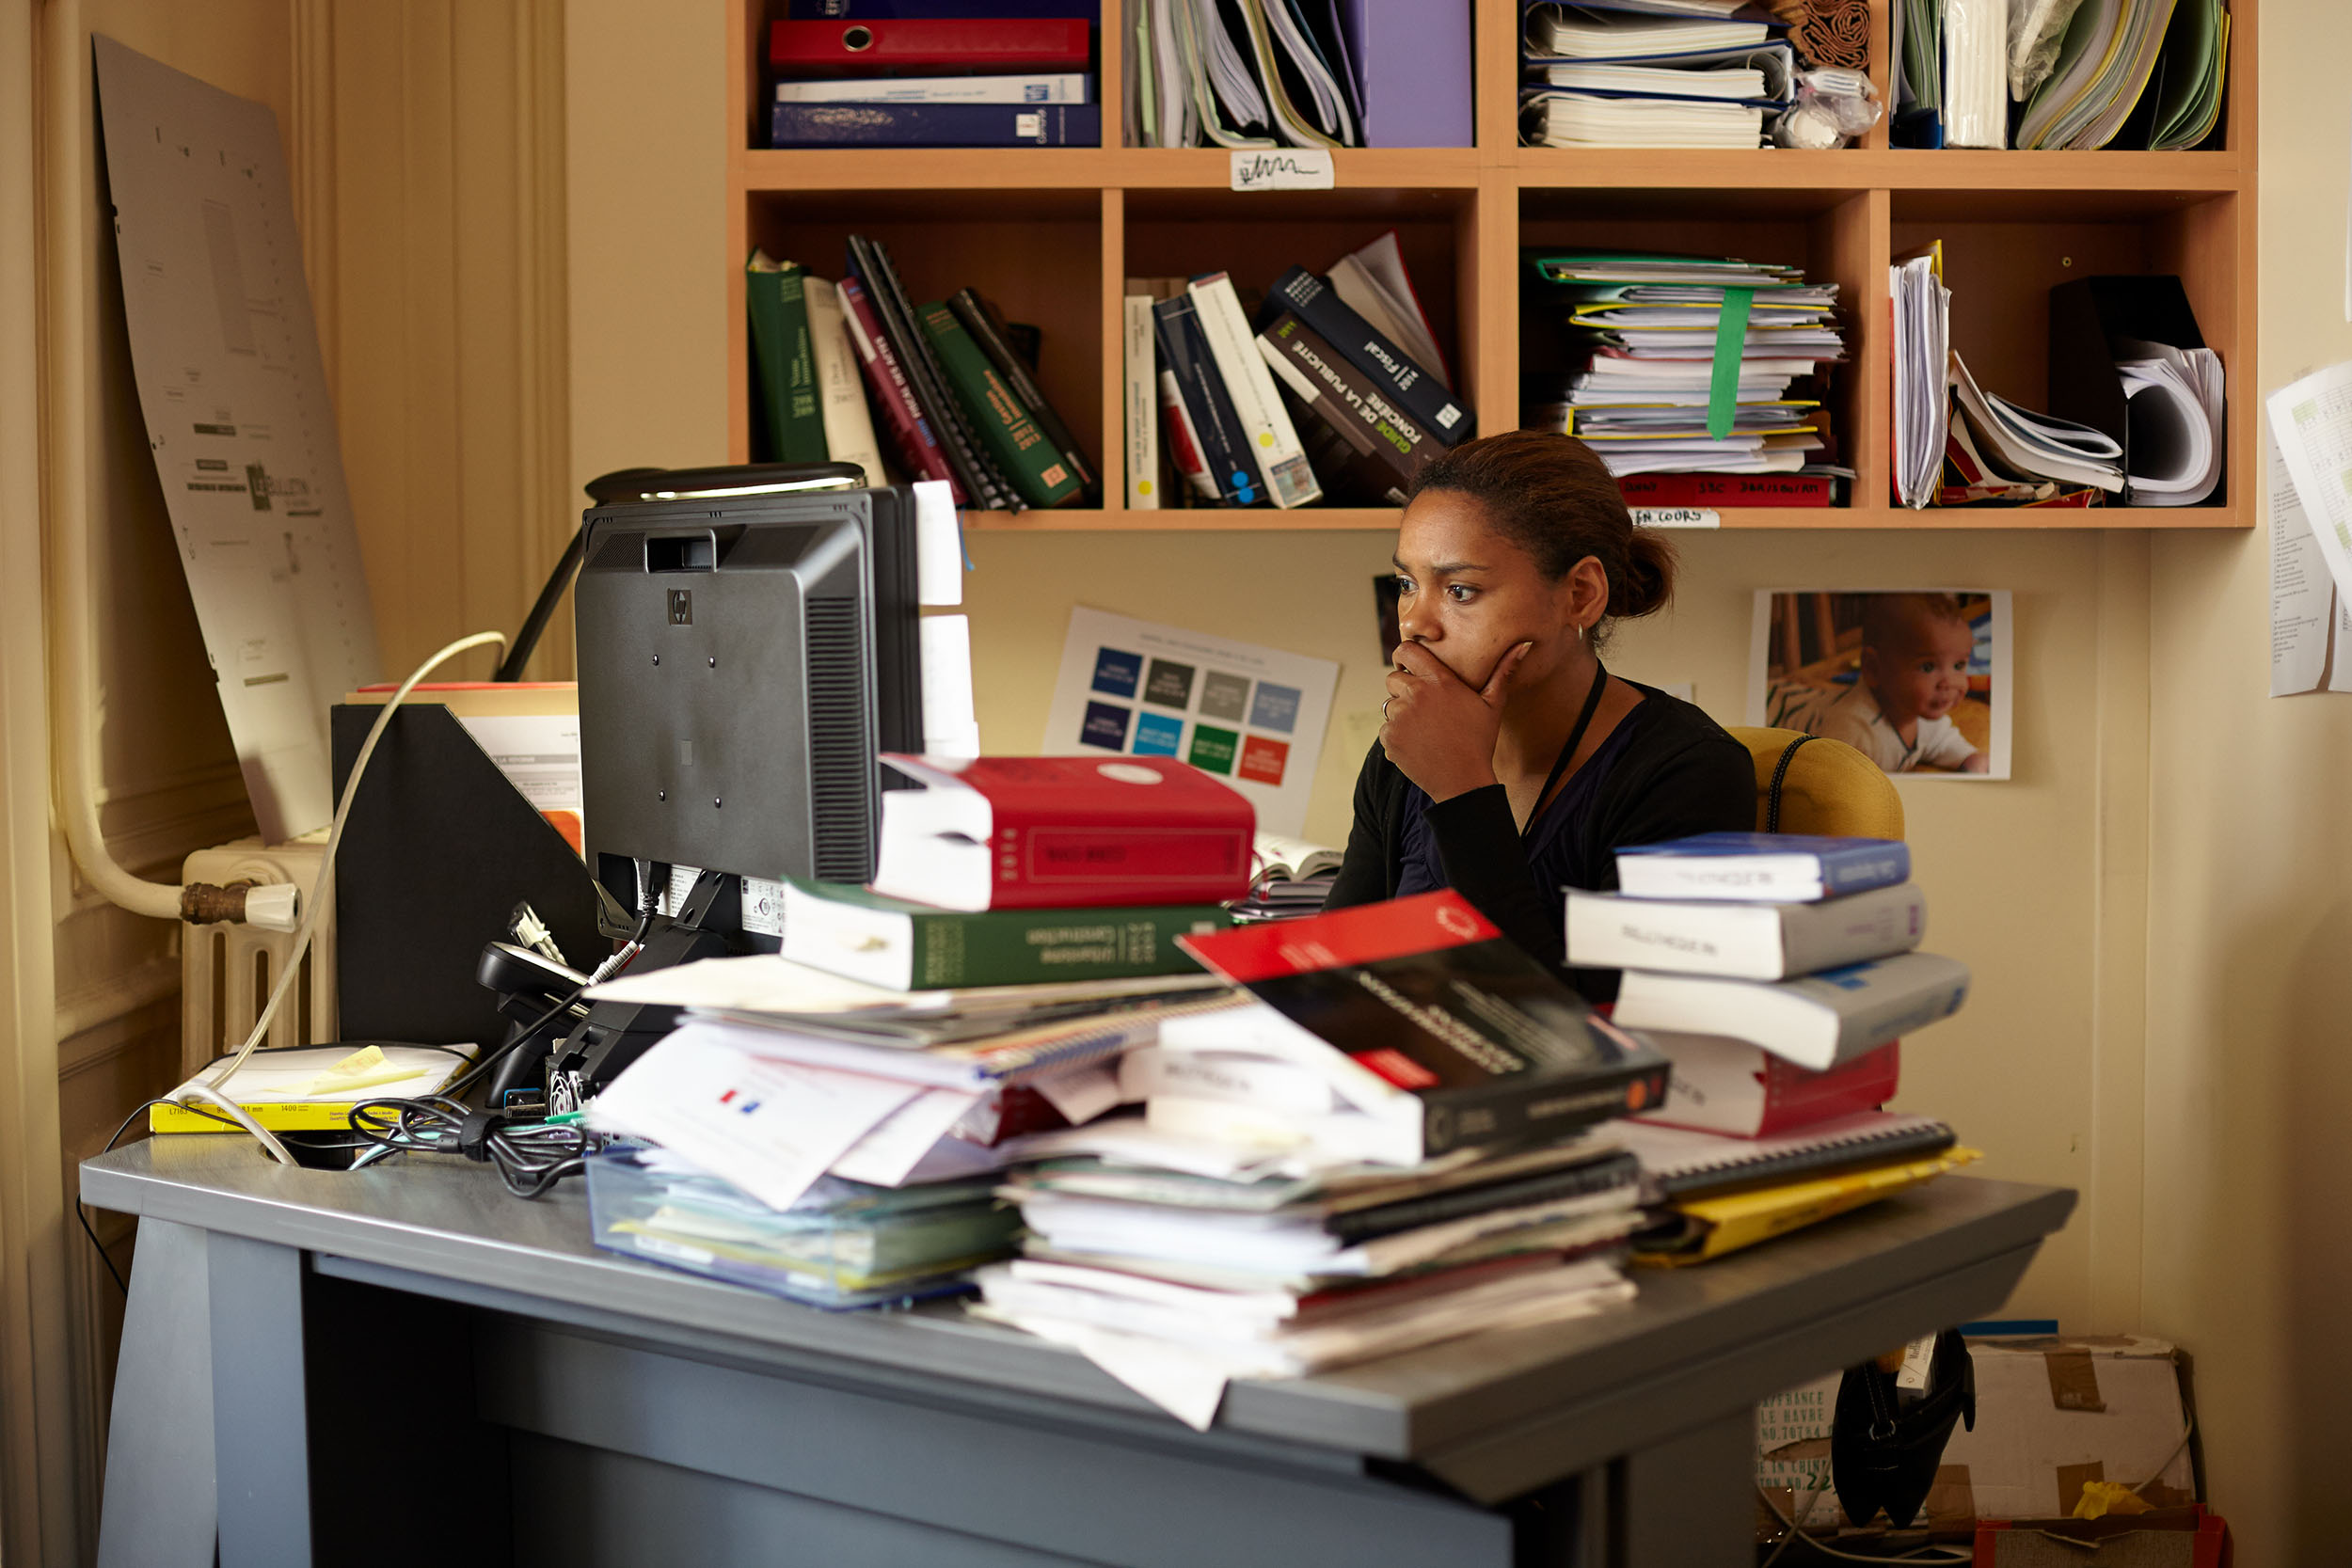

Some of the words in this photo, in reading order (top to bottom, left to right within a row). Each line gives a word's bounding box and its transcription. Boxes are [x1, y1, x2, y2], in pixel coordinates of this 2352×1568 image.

[1291, 340, 1345, 392] PUBLICITÉ
[1363, 341, 1400, 375] Fiscal
[1343, 388, 1363, 410] LA
[1358, 403, 1379, 424] DE
[1364, 391, 1422, 444] FONCIÈRE
[1374, 420, 1412, 453] GUIDE
[1760, 1408, 1776, 1423] LE
[1783, 1407, 1823, 1423] HAVRE
